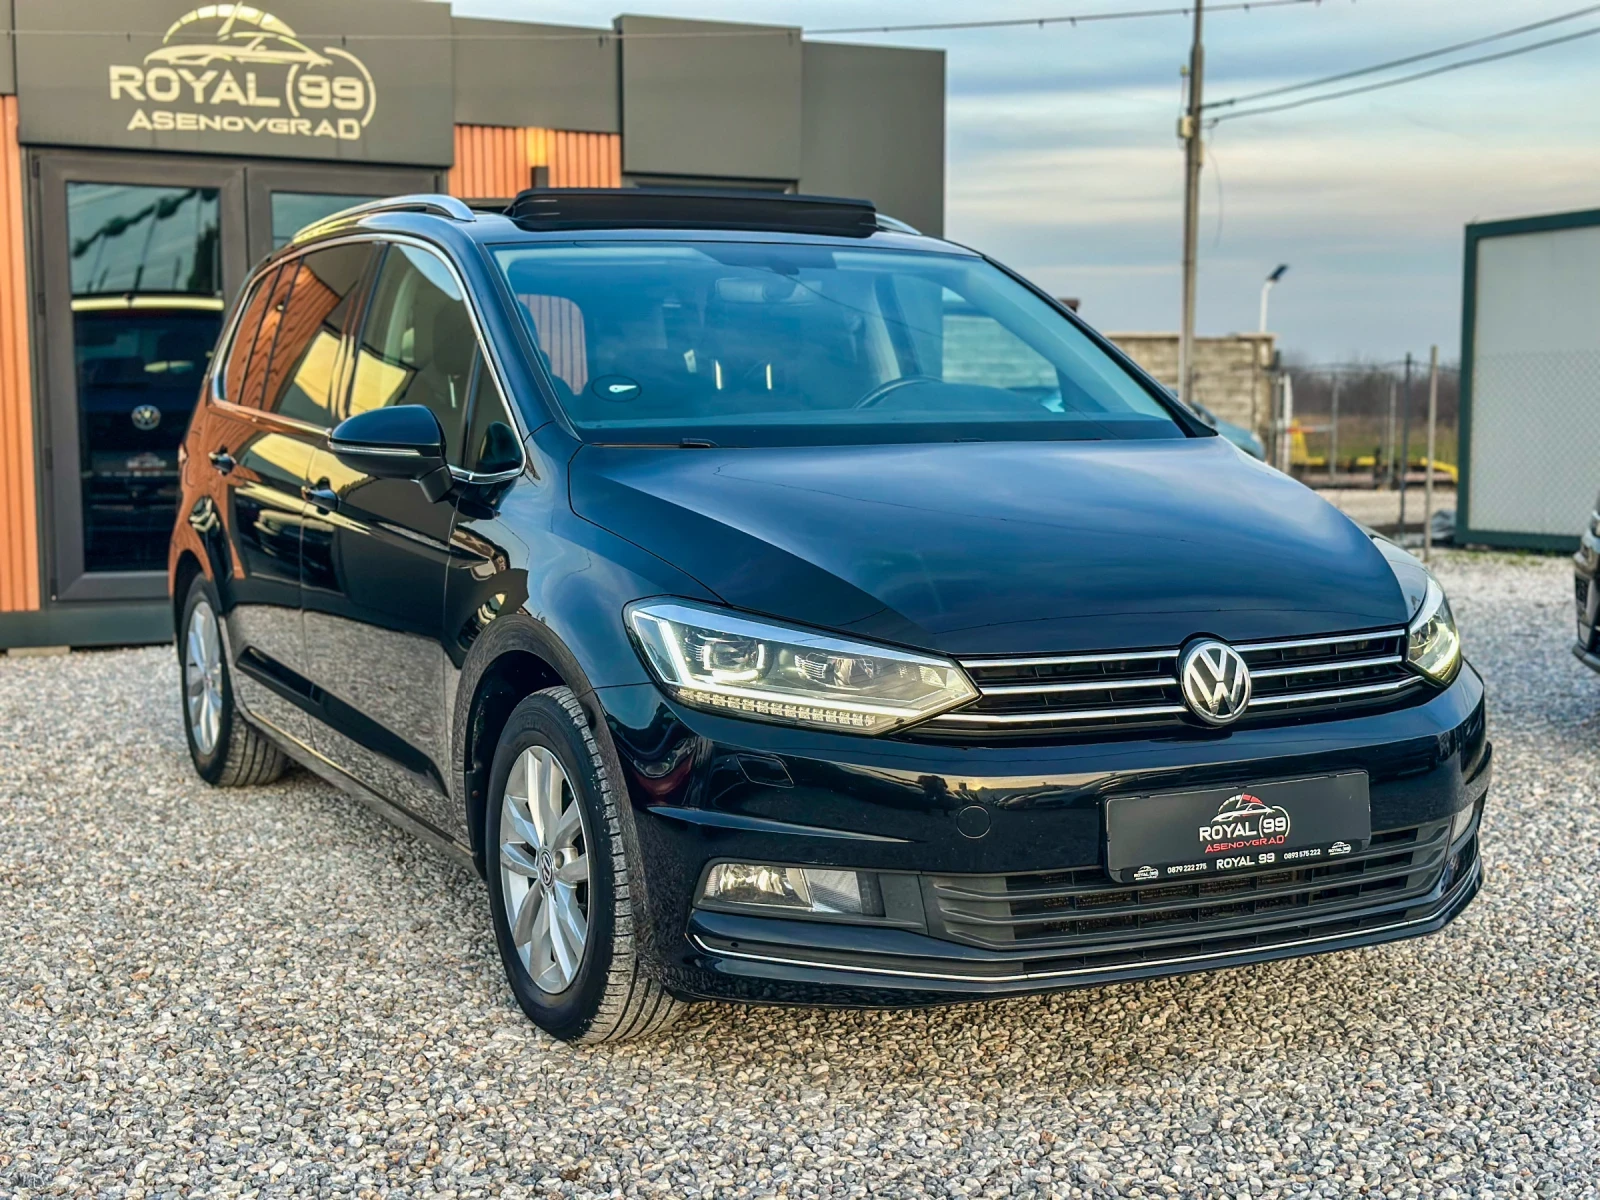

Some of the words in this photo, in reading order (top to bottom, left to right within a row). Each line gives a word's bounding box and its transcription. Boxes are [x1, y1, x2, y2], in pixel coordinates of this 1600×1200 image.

[109, 65, 281, 107] ROYAL
[127, 108, 361, 140] ASENOVGRAD
[1199, 821, 1257, 841] ROYAL
[1205, 835, 1285, 853] ASENOVGRAD
[1310, 848, 1321, 856] 222
[1167, 866, 1182, 874] 0879
[1216, 856, 1255, 870] ROYAL
[1258, 852, 1275, 864] 99
